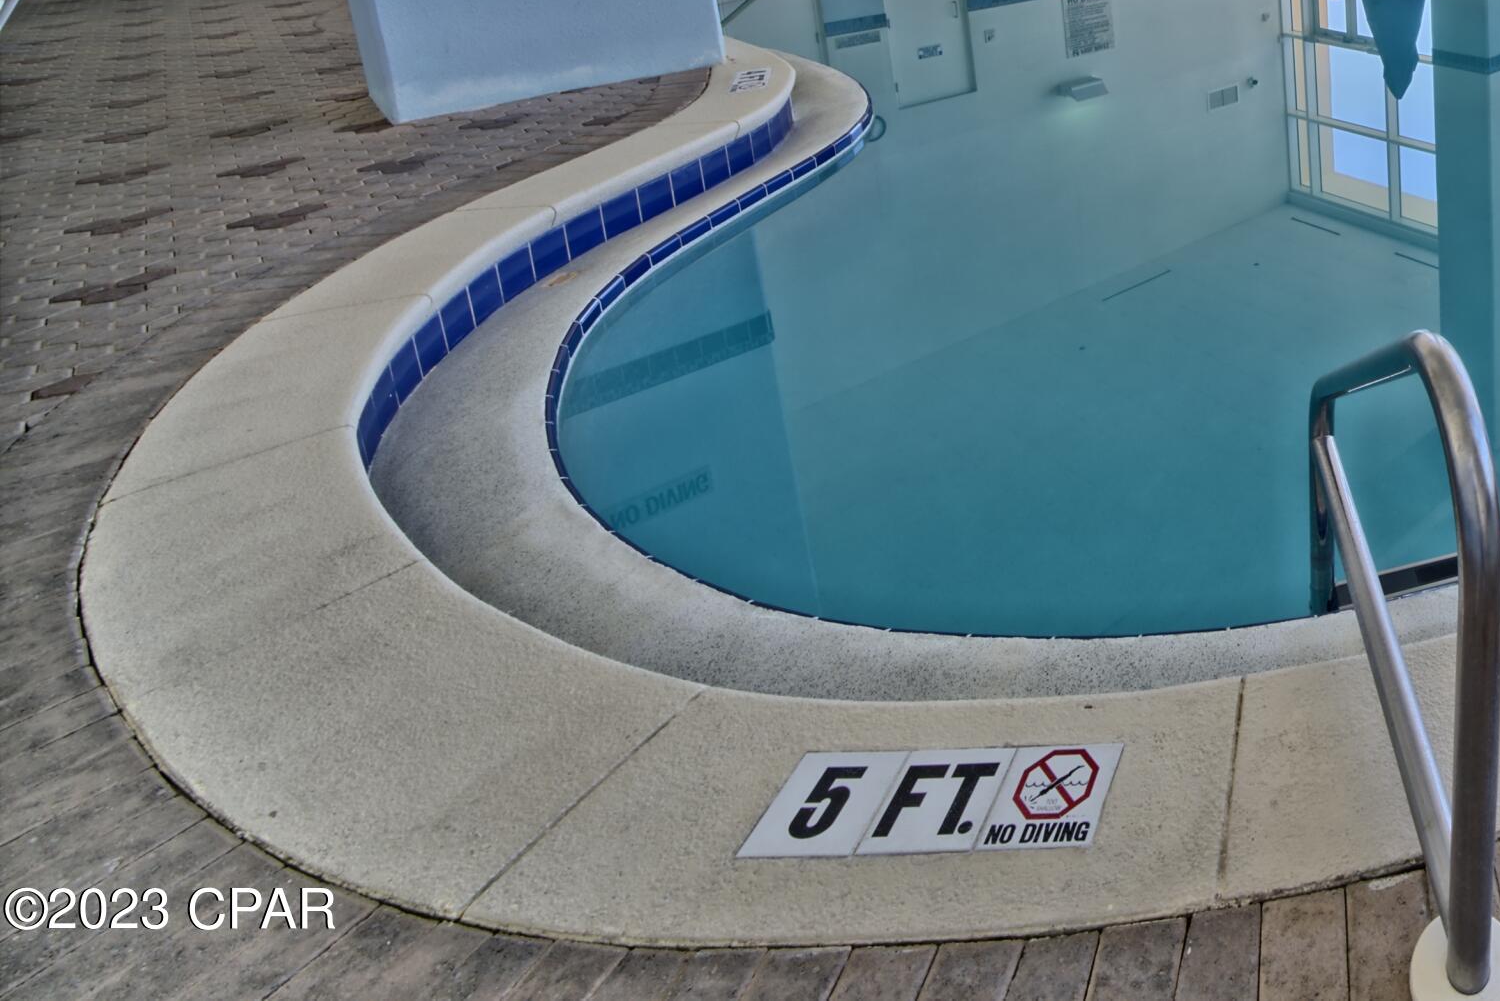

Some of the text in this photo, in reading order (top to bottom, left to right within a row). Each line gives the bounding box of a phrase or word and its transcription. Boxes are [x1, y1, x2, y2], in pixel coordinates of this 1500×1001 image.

[788, 762, 1000, 839] 5 FT.
[984, 821, 1091, 845] NO DIVING
